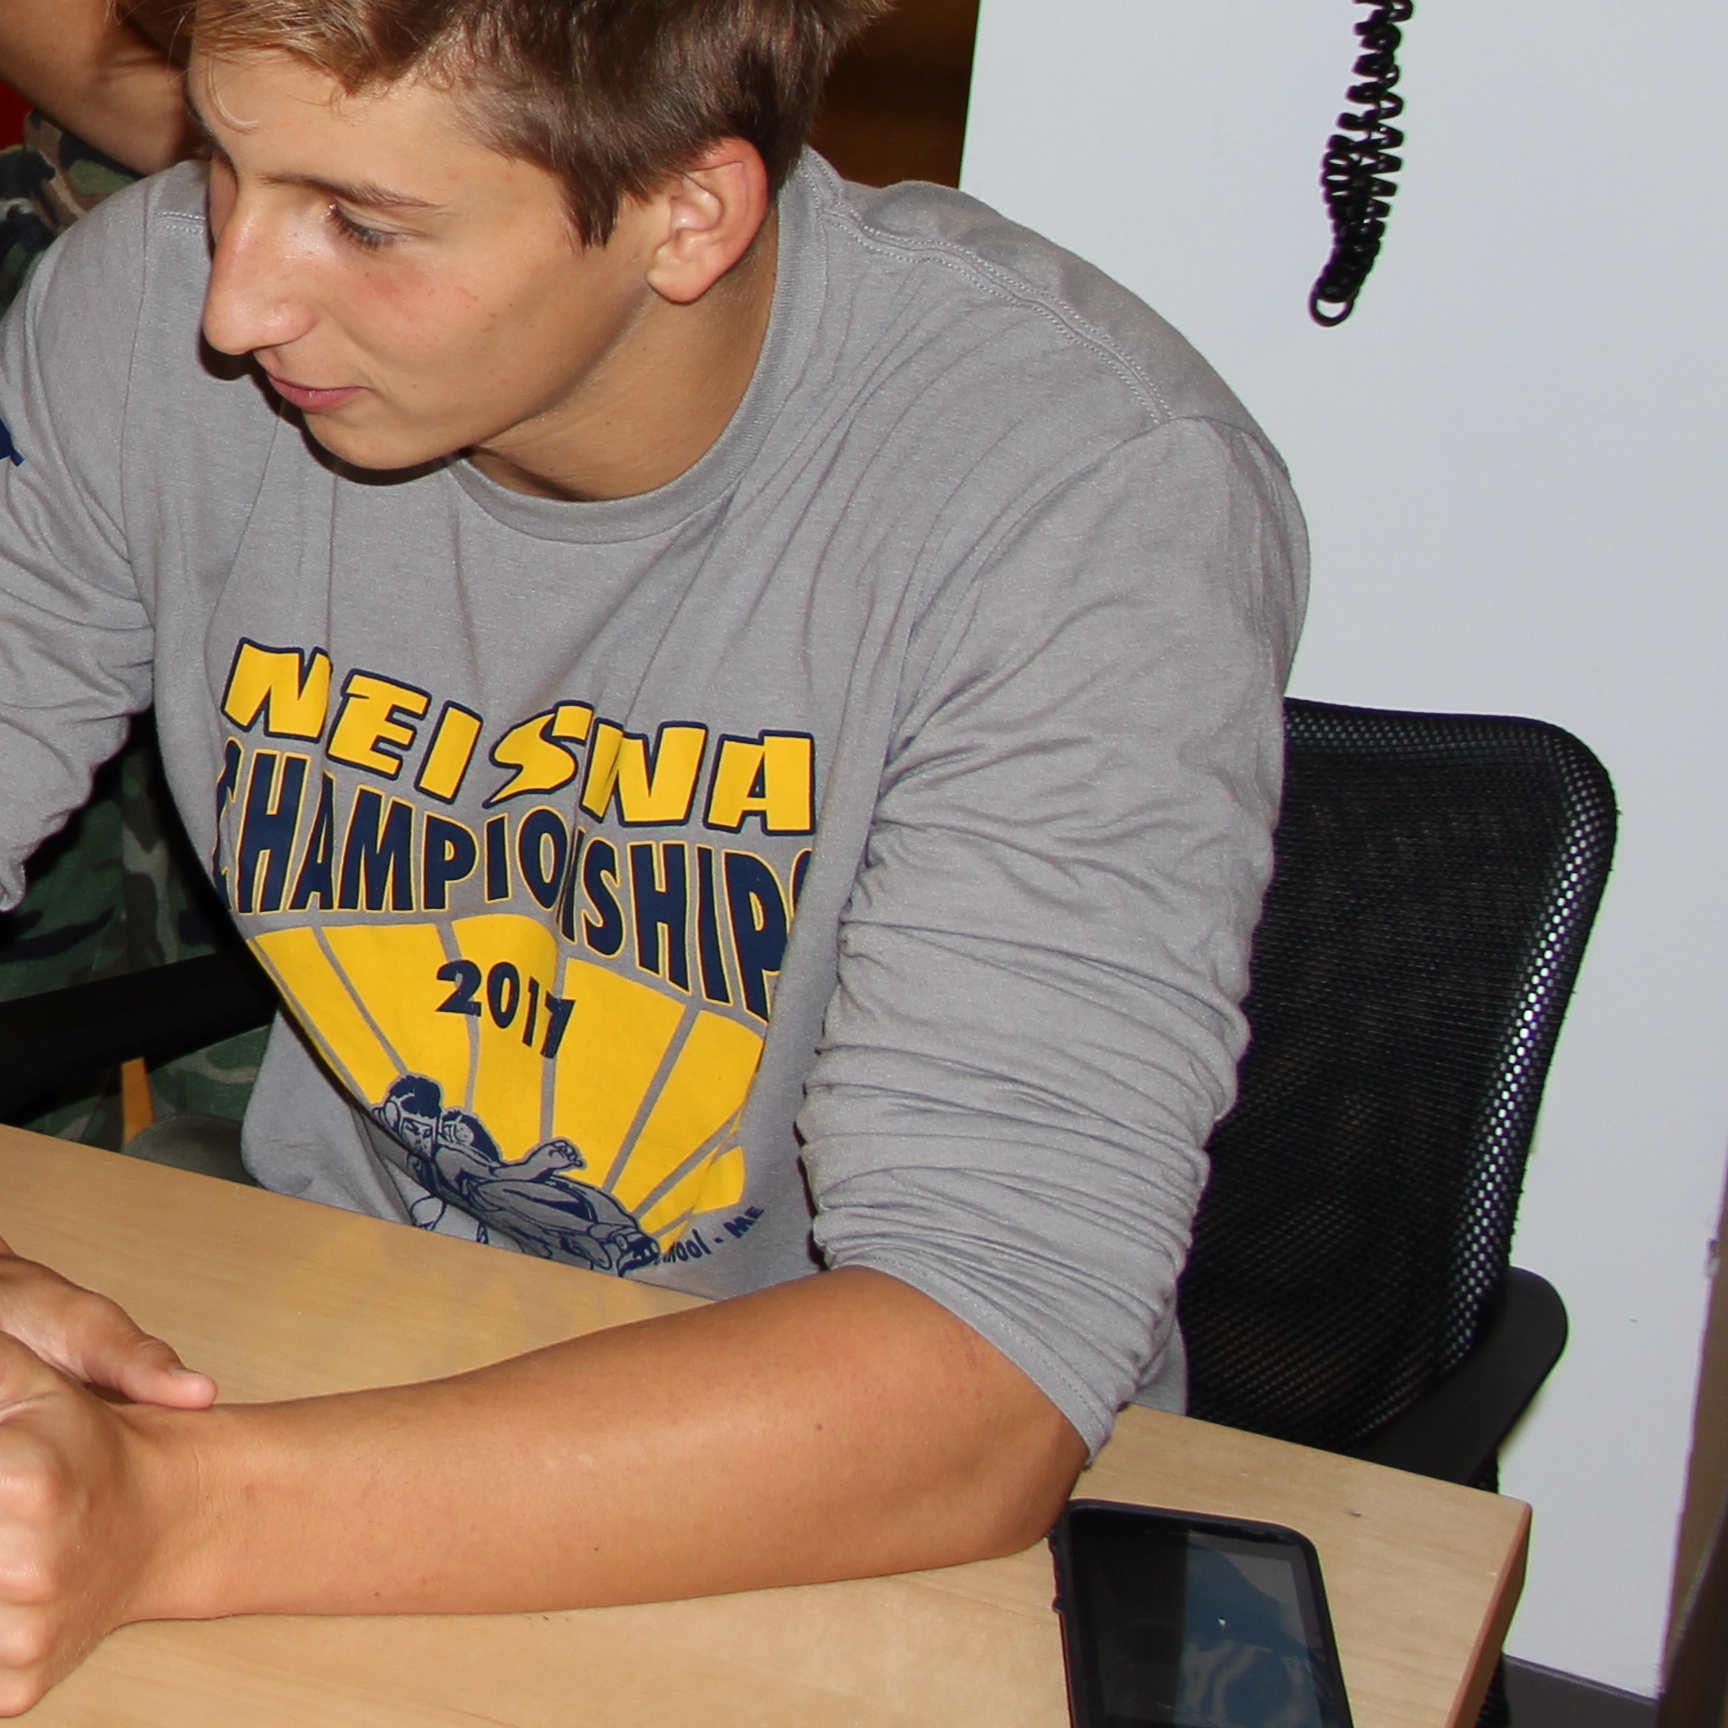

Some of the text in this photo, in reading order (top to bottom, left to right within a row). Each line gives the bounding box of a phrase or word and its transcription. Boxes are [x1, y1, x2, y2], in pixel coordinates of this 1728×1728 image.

[214, 737, 810, 1024] CHAMPIOSHIP
[435, 958, 577, 1060] 2017
[723, 1205, 765, 1239] ME
